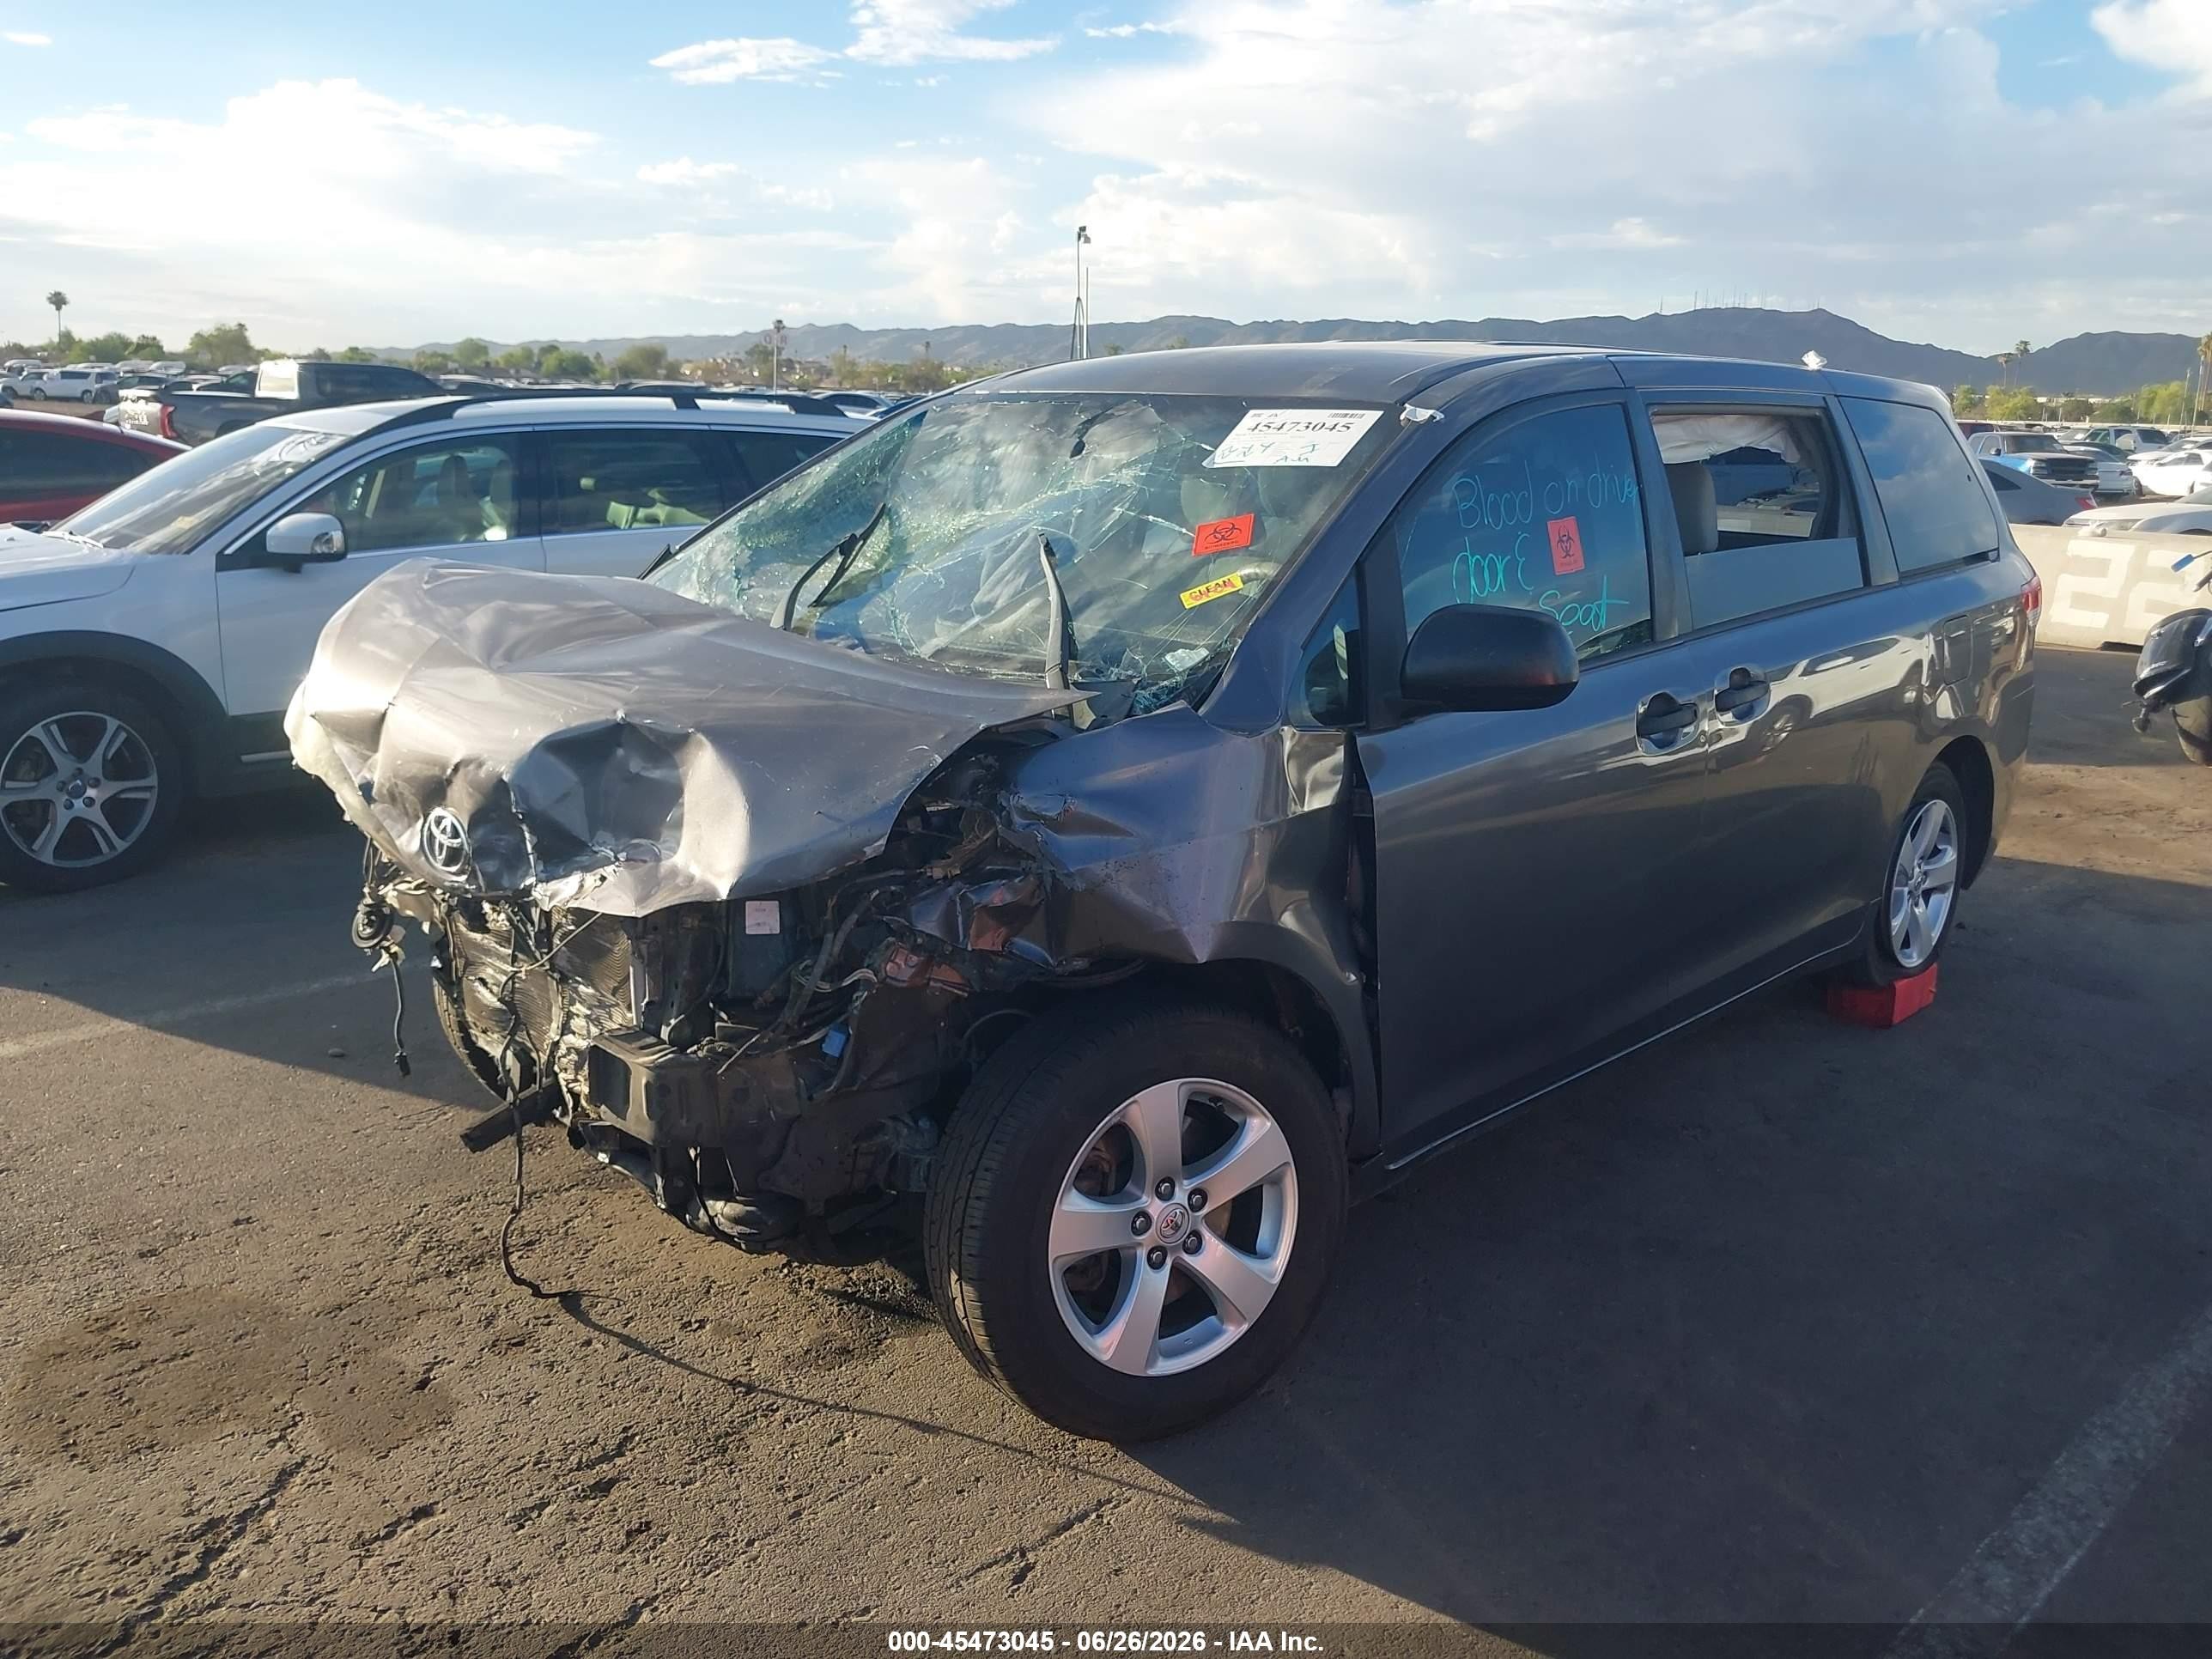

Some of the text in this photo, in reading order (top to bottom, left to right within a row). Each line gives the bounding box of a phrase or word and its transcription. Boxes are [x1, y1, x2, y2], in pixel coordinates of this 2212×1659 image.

[1248, 421, 1355, 433] 45473045
[1452, 460, 1533, 530] Blood
[1544, 480, 1579, 514] on
[1188, 578, 1235, 601] CLEAN
[1452, 536, 1511, 604] door
[2050, 538, 2206, 629] 22
